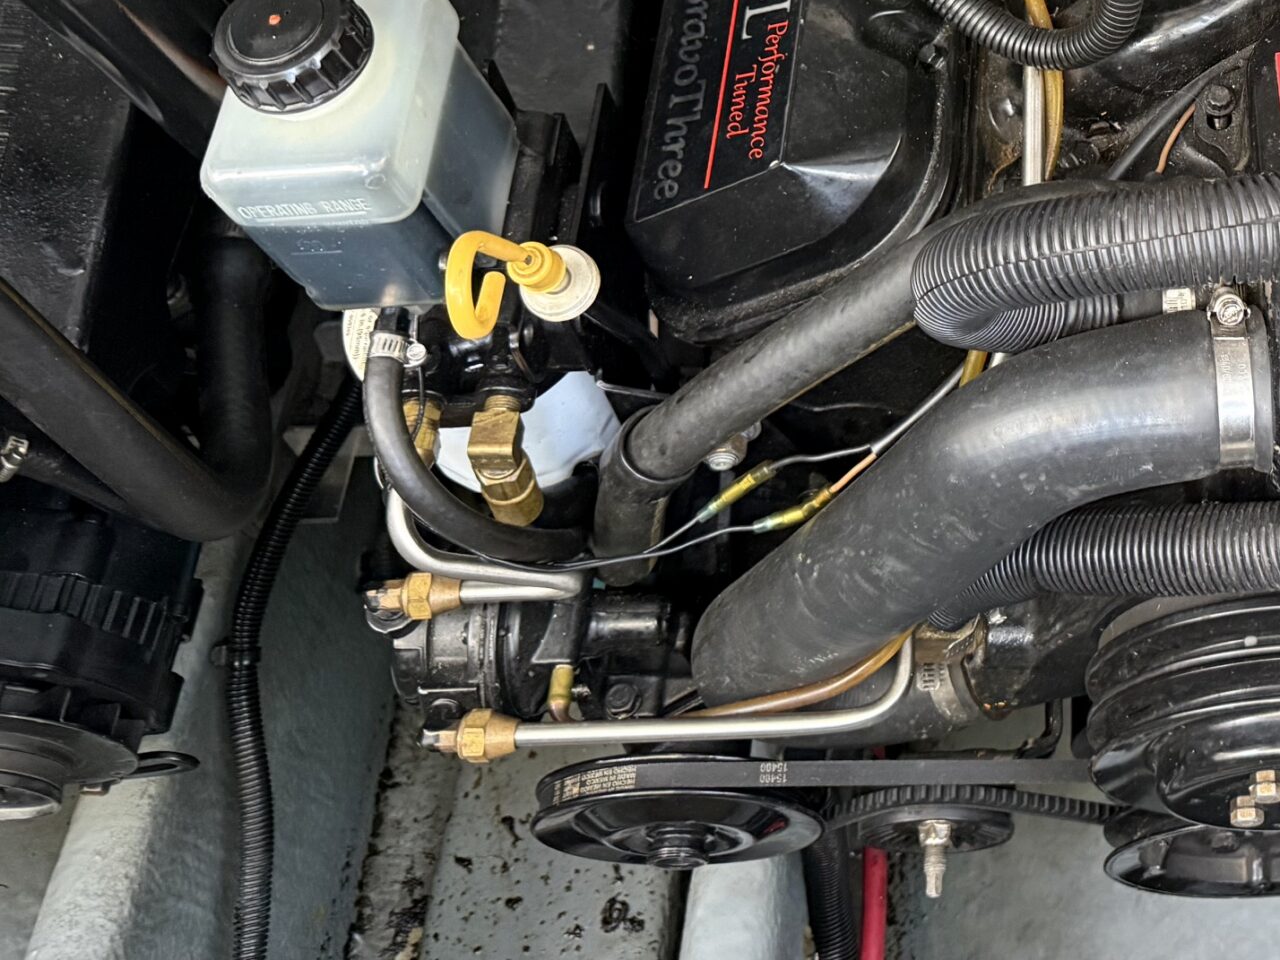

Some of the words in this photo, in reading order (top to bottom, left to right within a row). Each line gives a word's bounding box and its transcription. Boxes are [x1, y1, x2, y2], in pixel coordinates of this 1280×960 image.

[726, 64, 757, 139] Tuned
[748, 20, 789, 160] Performance
[238, 202, 317, 219] OPERATING
[319, 198, 372, 214] RANGE
